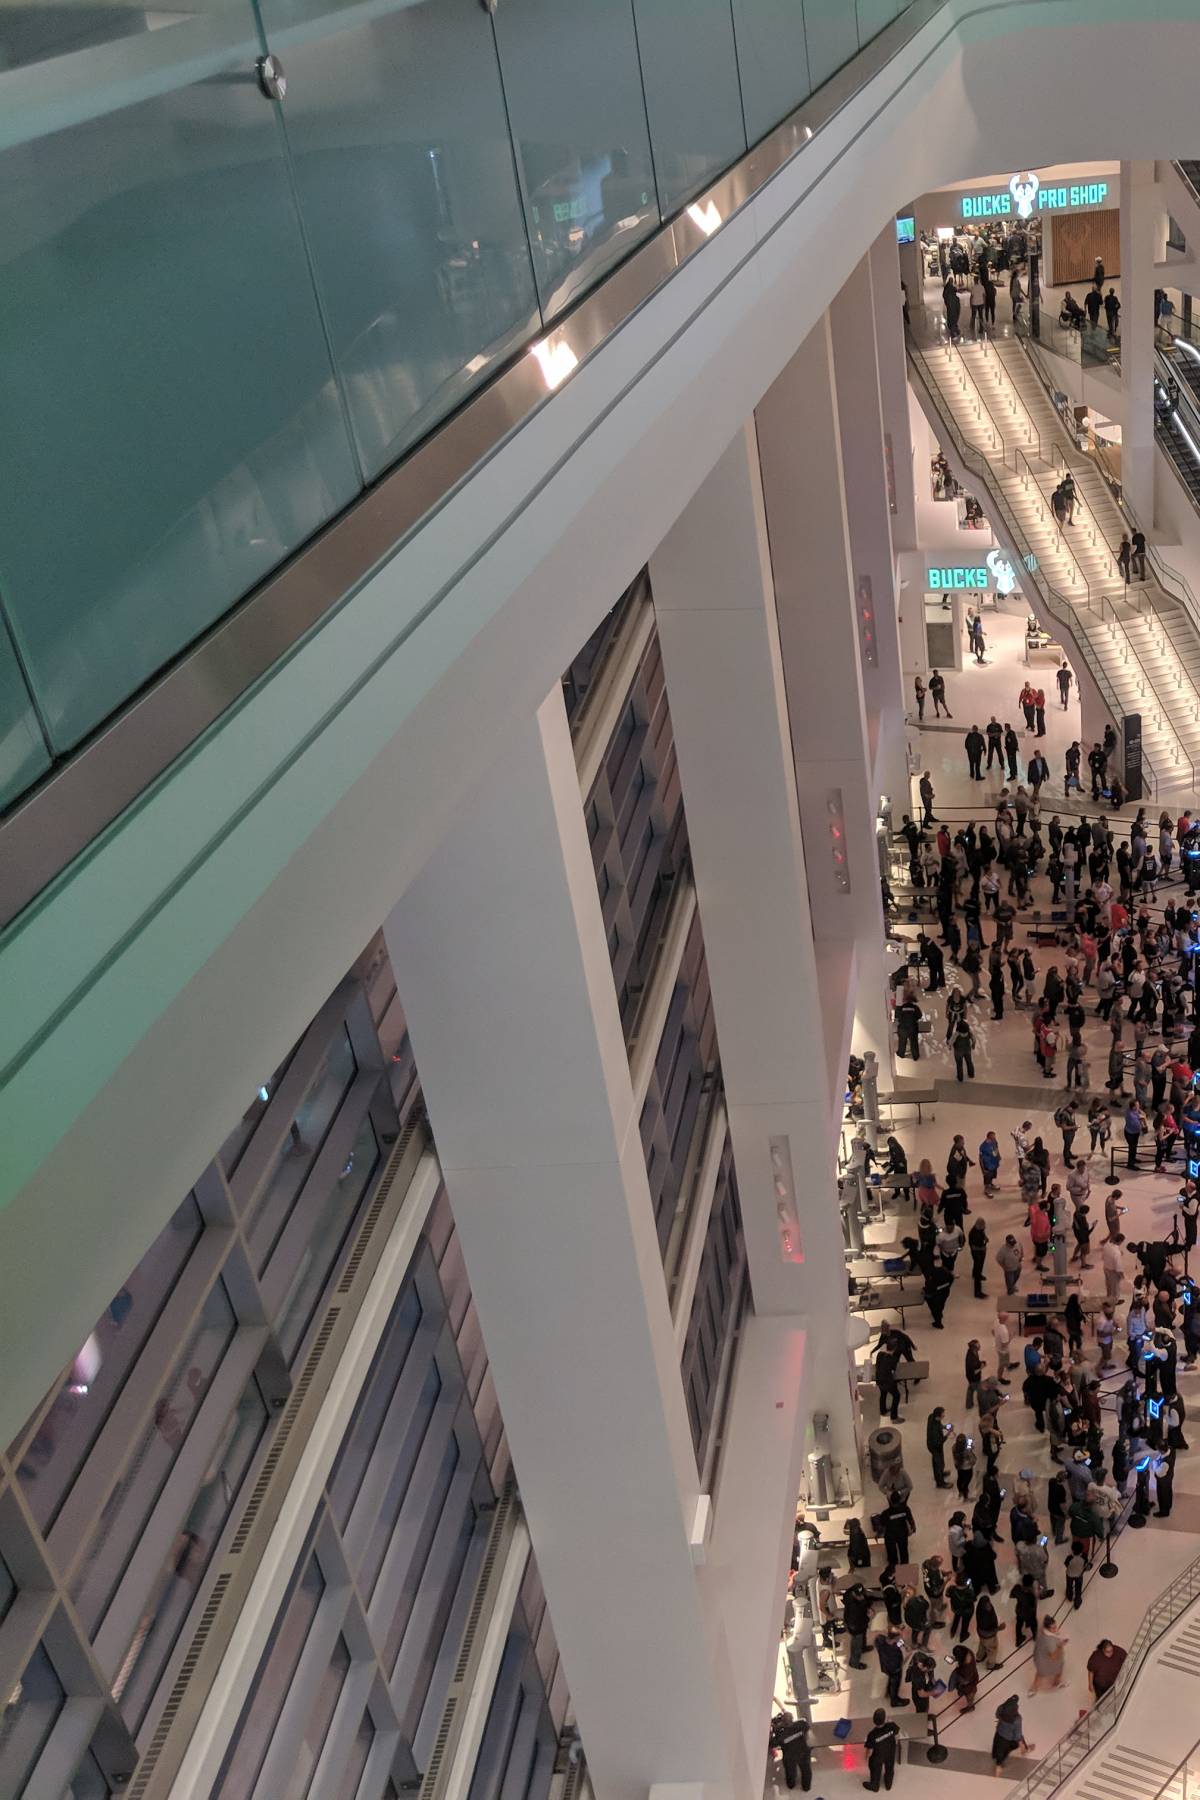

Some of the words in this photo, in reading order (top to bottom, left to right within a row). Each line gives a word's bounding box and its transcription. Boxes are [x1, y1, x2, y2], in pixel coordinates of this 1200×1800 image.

[962, 193, 1011, 218] BUCKS
[1039, 189, 1067, 210] PRO
[1070, 183, 1108, 206] SHOP
[928, 567, 988, 589] BUCKS
